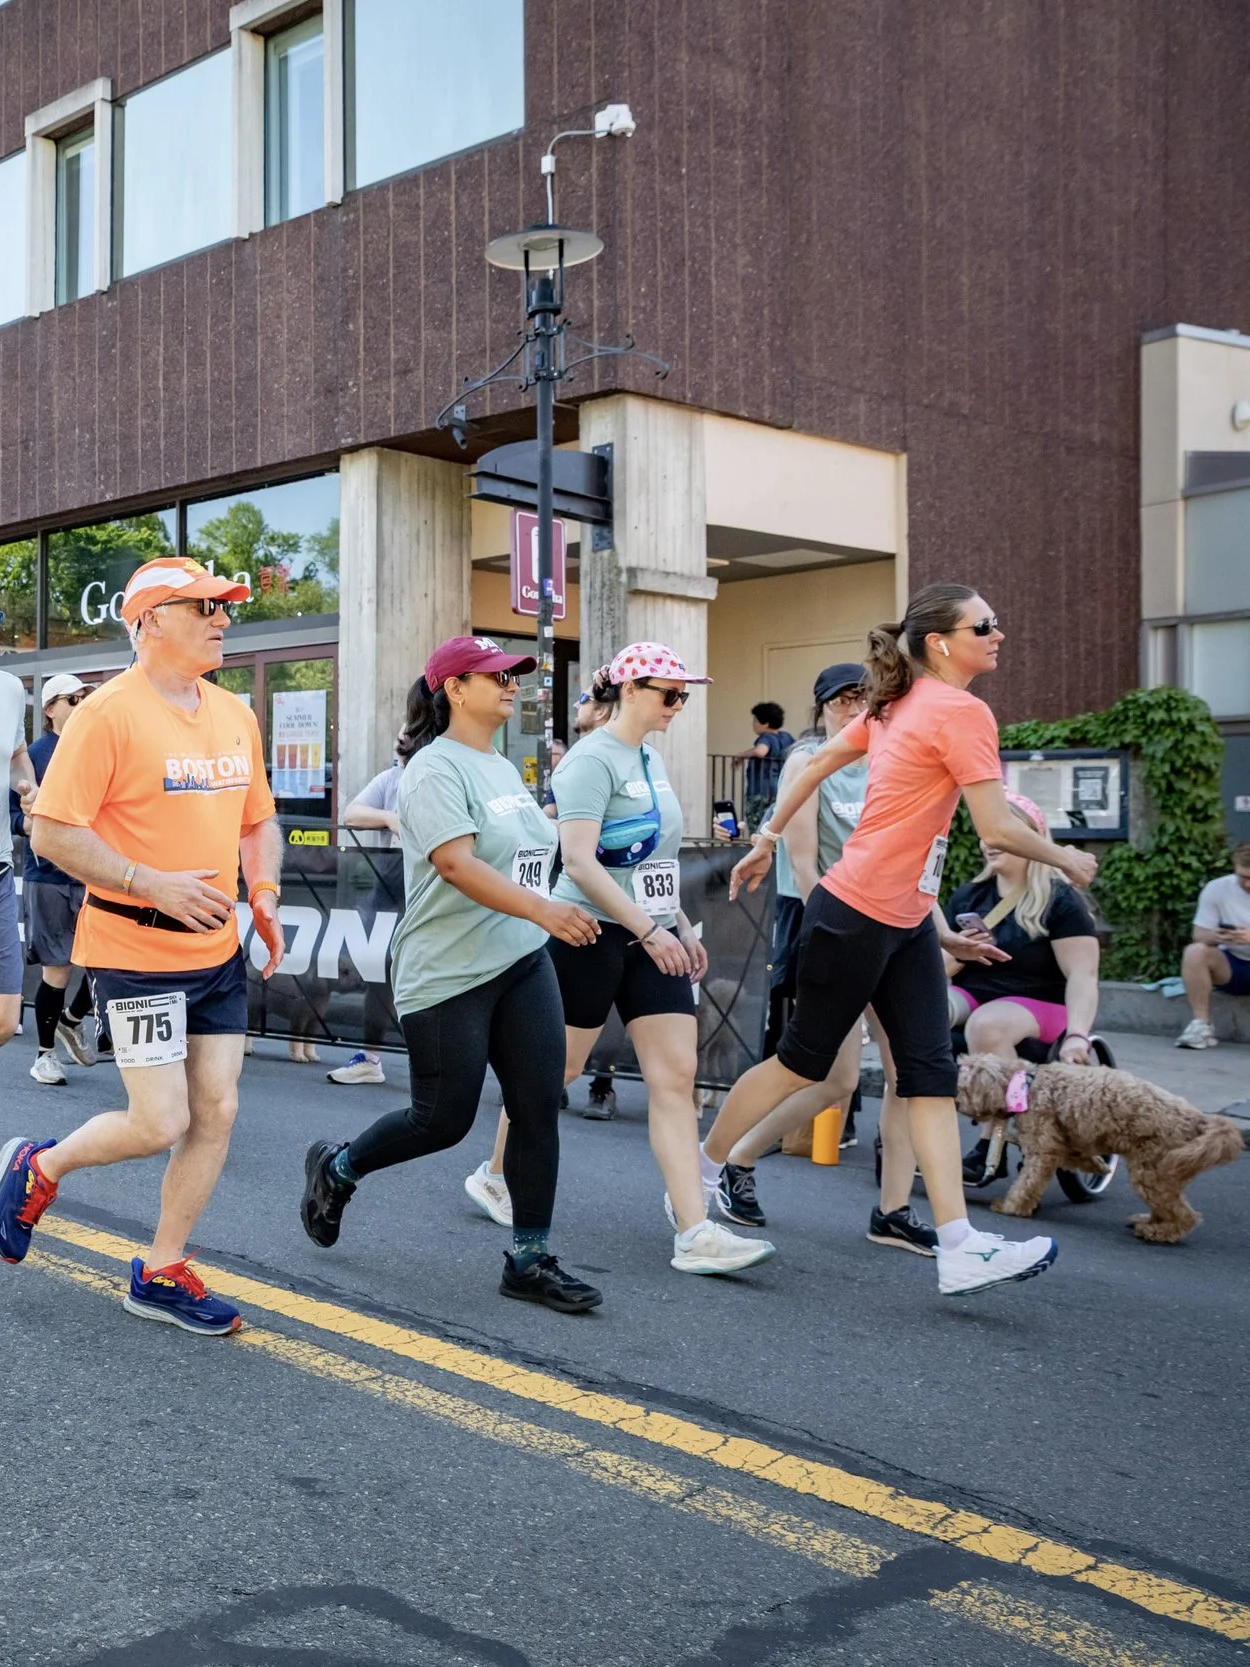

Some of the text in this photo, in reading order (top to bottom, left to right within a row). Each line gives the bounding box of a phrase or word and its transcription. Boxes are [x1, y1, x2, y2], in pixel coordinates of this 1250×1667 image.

[166, 756, 249, 784] BOSTON
[519, 861, 541, 887] 249
[643, 873, 673, 897] 833
[115, 996, 169, 1011] BIONIC
[127, 1012, 172, 1045] 775
[12, 1142, 34, 1171] HOKA
